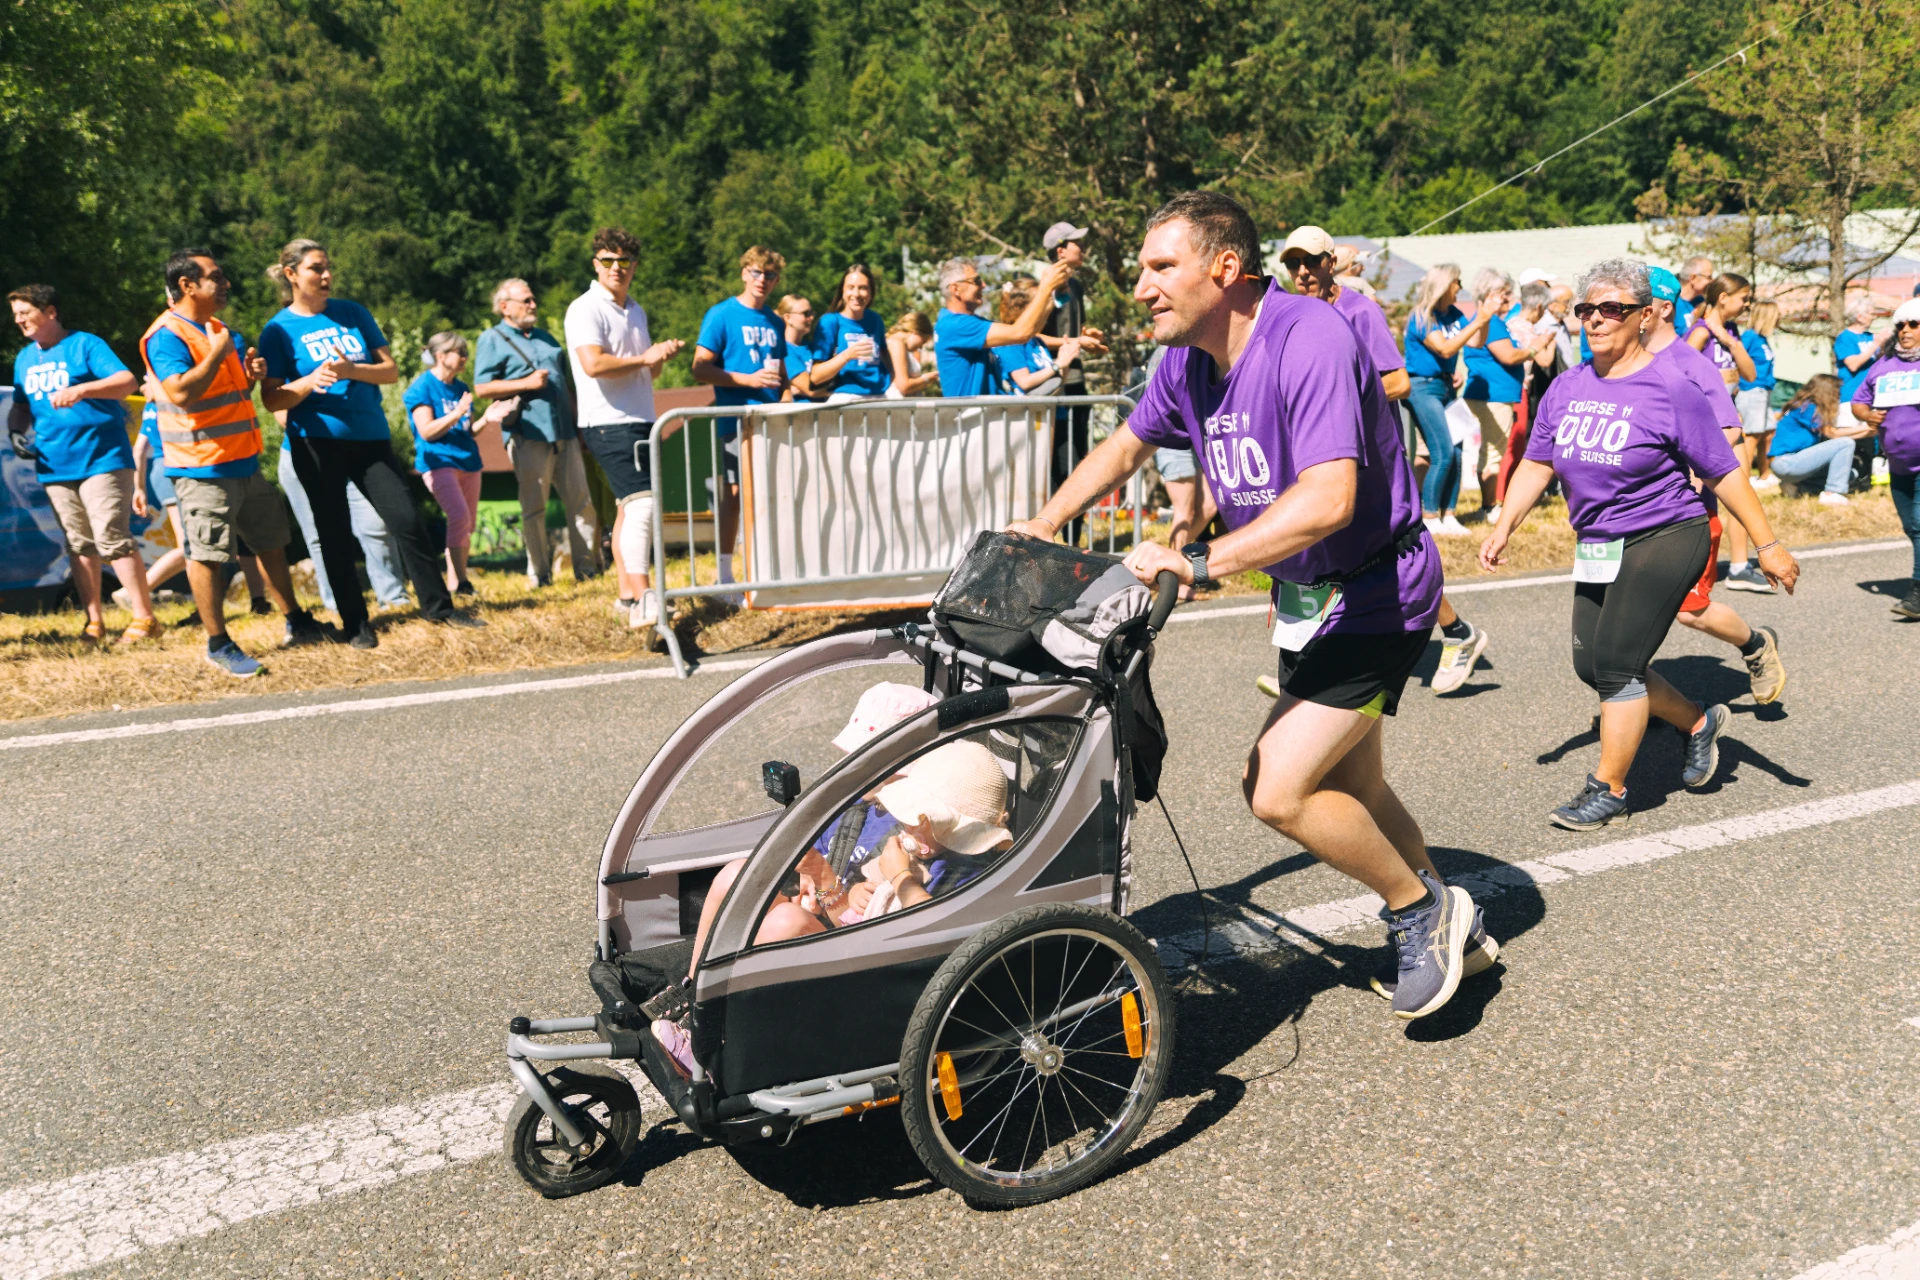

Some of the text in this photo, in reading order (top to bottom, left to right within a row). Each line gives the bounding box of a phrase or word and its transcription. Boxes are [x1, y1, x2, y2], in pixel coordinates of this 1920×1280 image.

[306, 334, 362, 362] DUO
[742, 326, 777, 347] DUO
[25, 369, 69, 394] DUO
[1567, 400, 1617, 416] COURSE
[1555, 415, 1630, 452] DUO
[1580, 450, 1623, 466] SUISSE
[1231, 488, 1277, 507] SUISSE
[1298, 584, 1319, 617] 5
